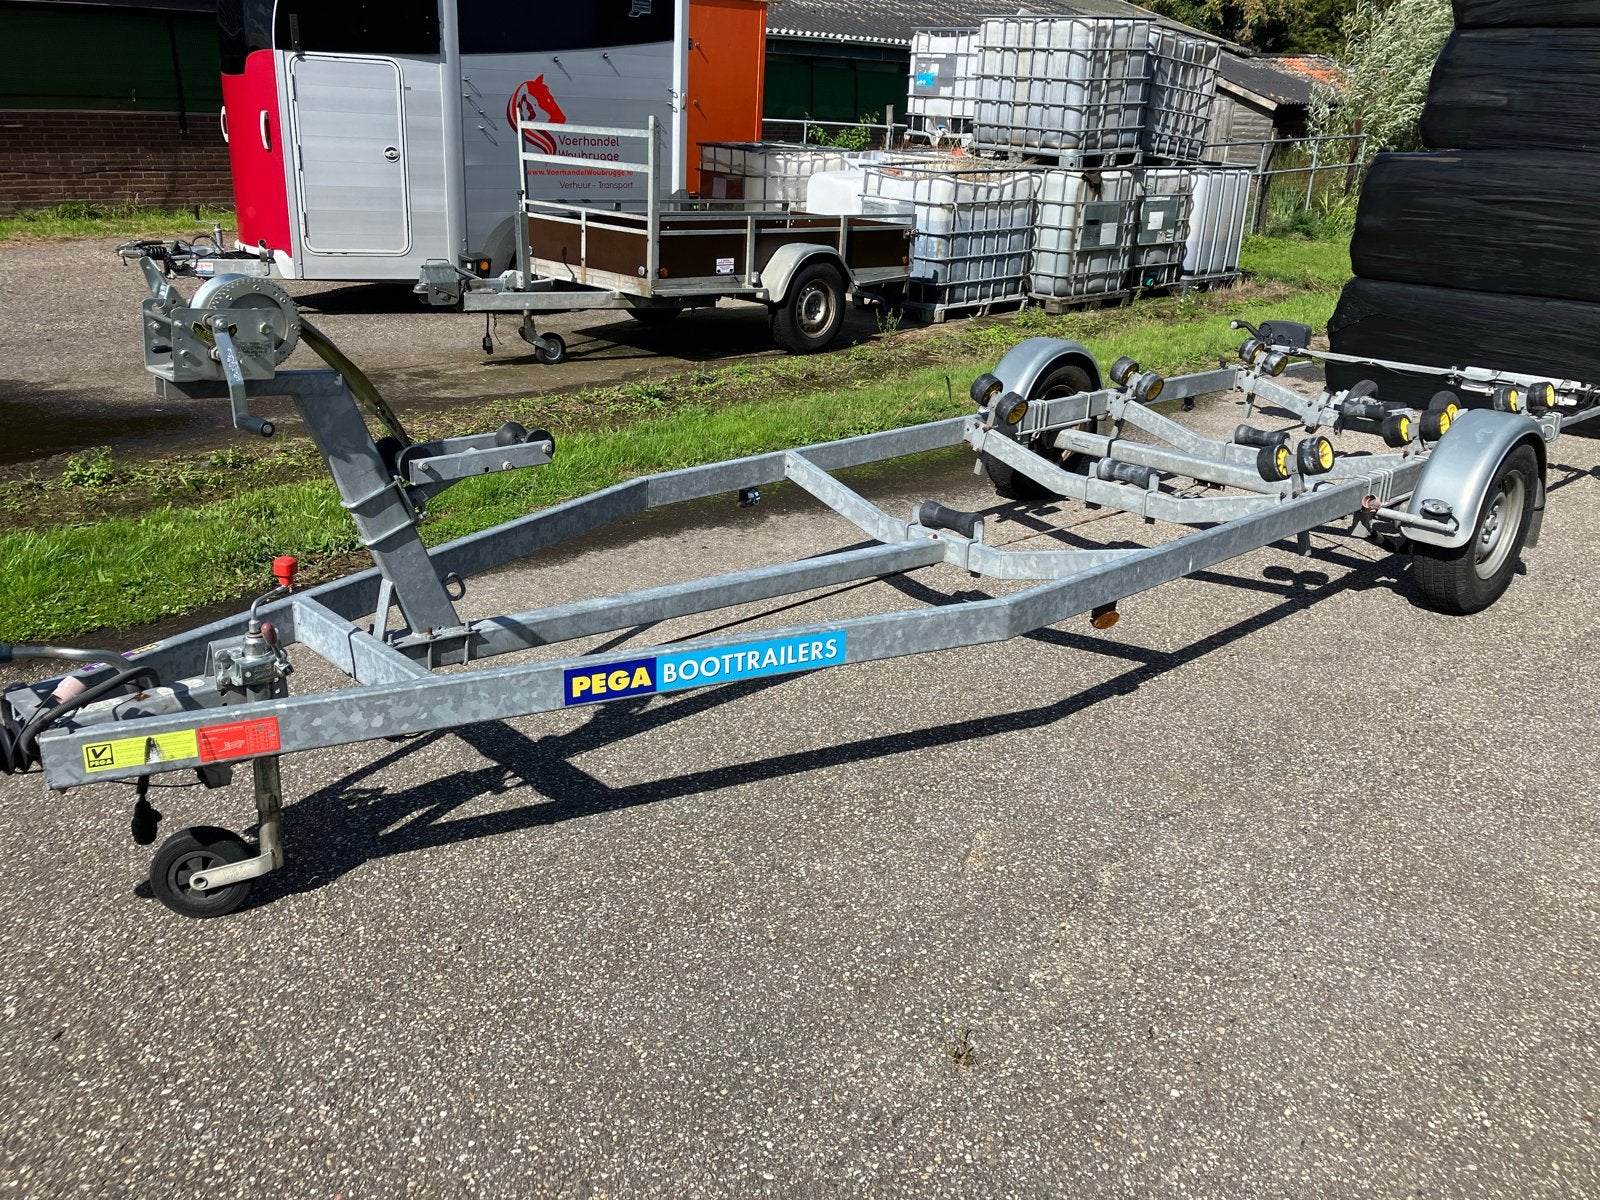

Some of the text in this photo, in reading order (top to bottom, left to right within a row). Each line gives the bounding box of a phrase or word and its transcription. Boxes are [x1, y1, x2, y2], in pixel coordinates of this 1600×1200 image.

[558, 135, 619, 147] Voerhandel
[560, 181, 590, 189] Verhuur
[598, 181, 633, 190] Transport
[571, 639, 838, 698] PEGA BOOTTRAILERS
